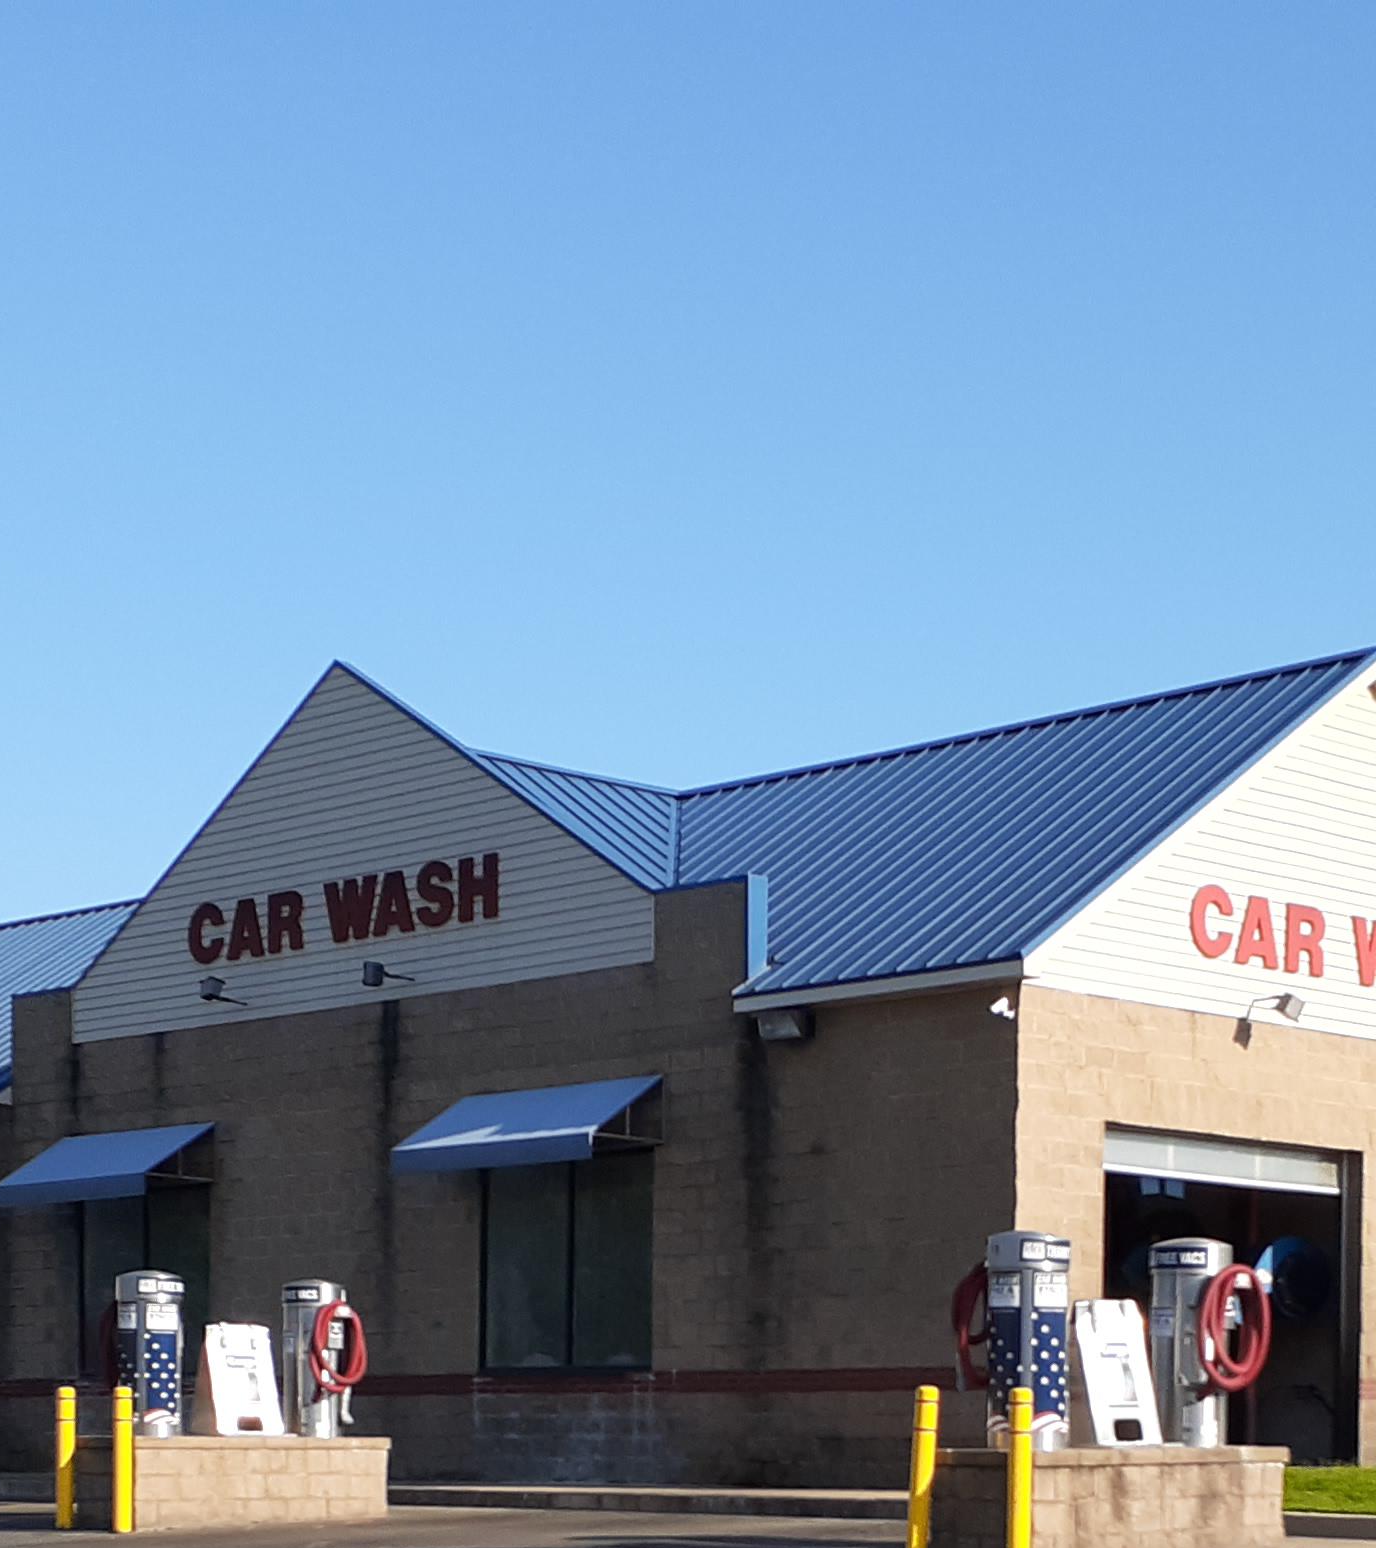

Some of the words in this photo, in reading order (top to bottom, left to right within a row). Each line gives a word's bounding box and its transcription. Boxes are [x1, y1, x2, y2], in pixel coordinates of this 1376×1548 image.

[187, 890, 304, 964] CAR
[323, 852, 500, 943] WASH
[1189, 884, 1325, 978] CAR
